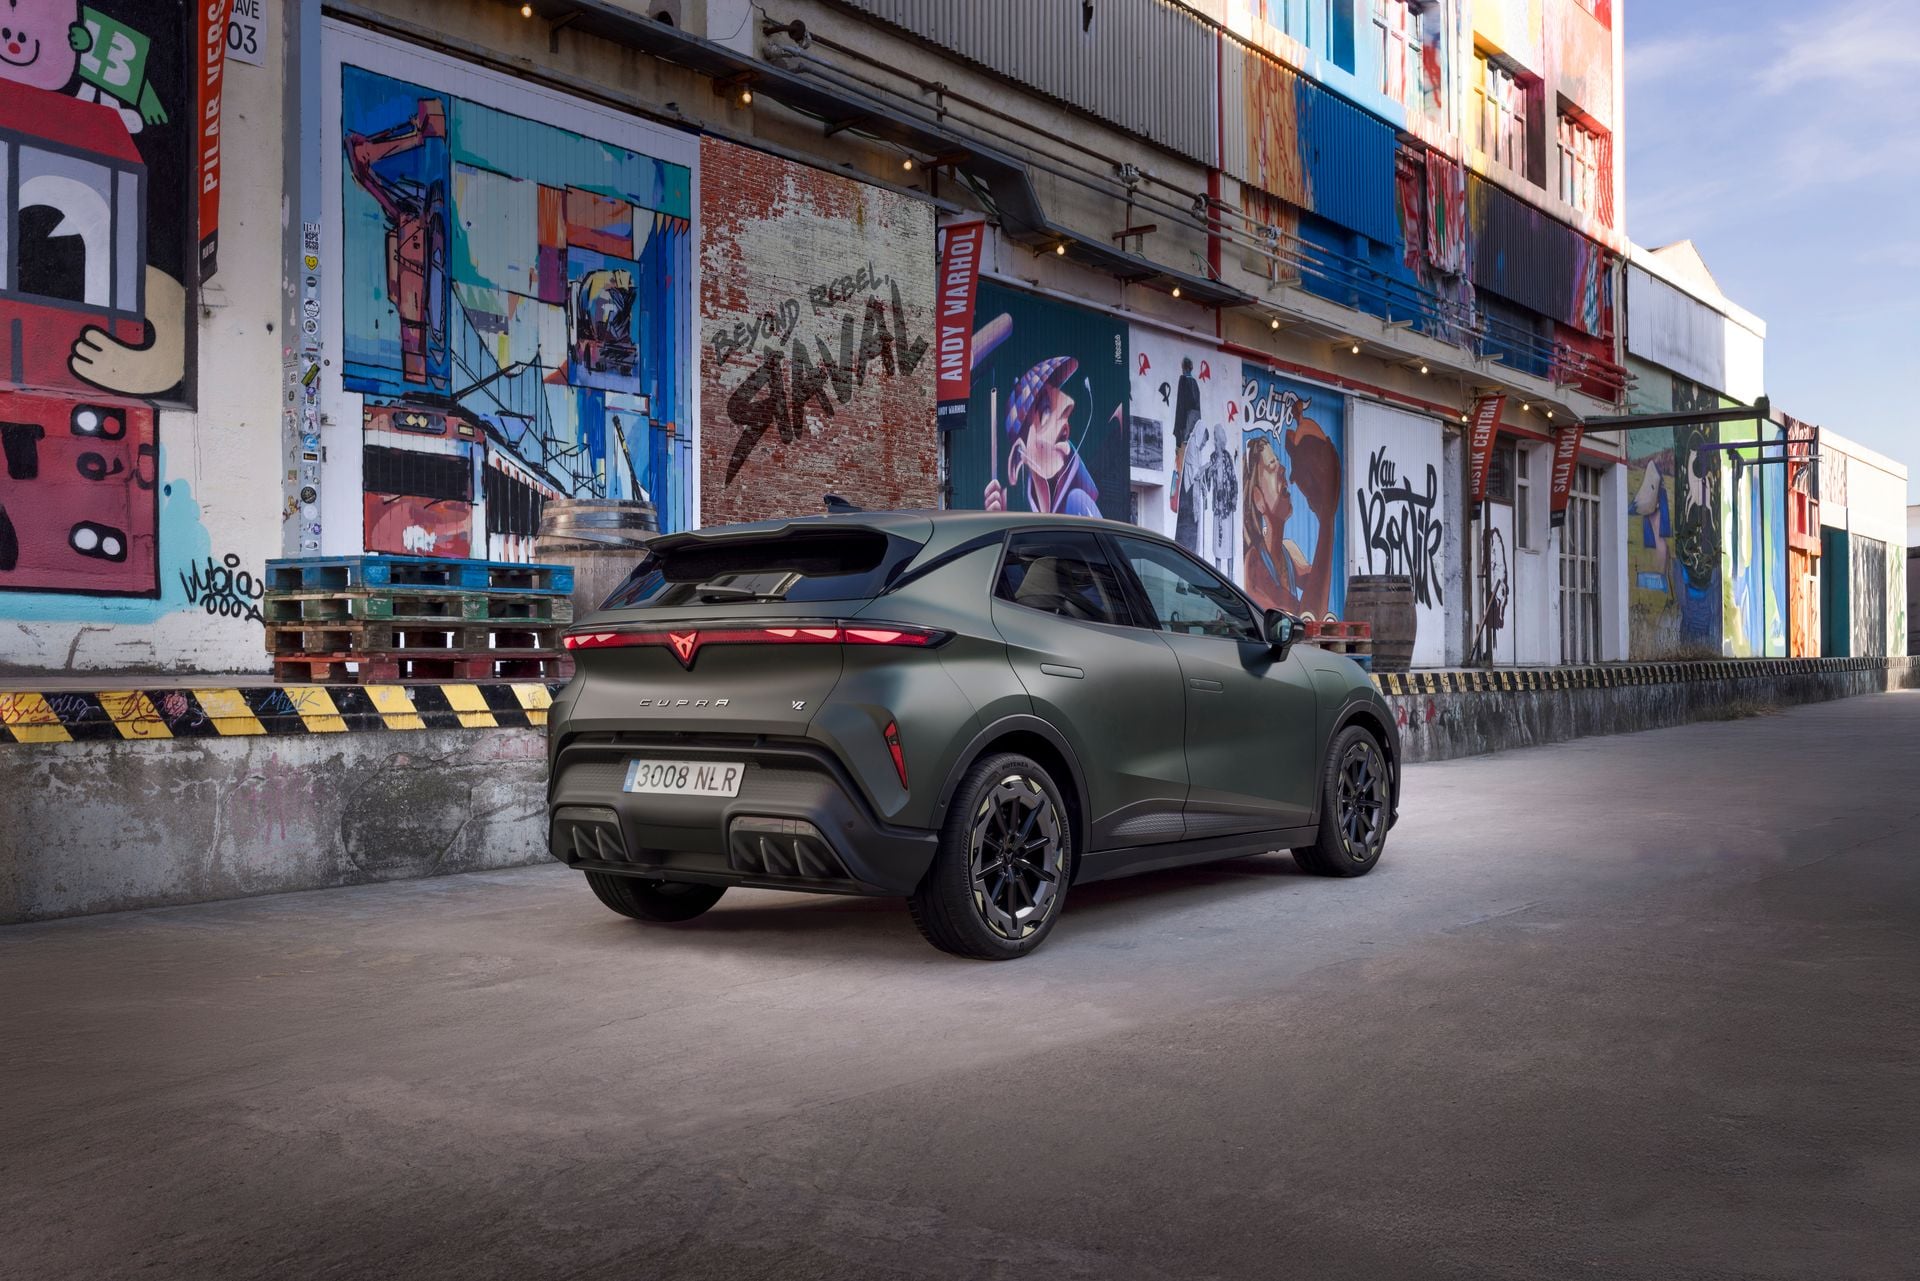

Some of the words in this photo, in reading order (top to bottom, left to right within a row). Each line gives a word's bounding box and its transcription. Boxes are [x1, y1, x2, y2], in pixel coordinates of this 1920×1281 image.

[231, 0, 260, 19] AVE
[227, 21, 258, 54] 03
[203, 92, 220, 194] PILAR
[943, 228, 976, 316] WARHOL
[711, 298, 800, 366] BEYOND
[940, 326, 965, 382] ANDY
[1473, 398, 1500, 448] CENTRAL
[1554, 462, 1571, 493] SALA
[638, 698, 730, 708] CUPRA
[637, 764, 690, 789] 3008
[693, 766, 737, 792] NLR
